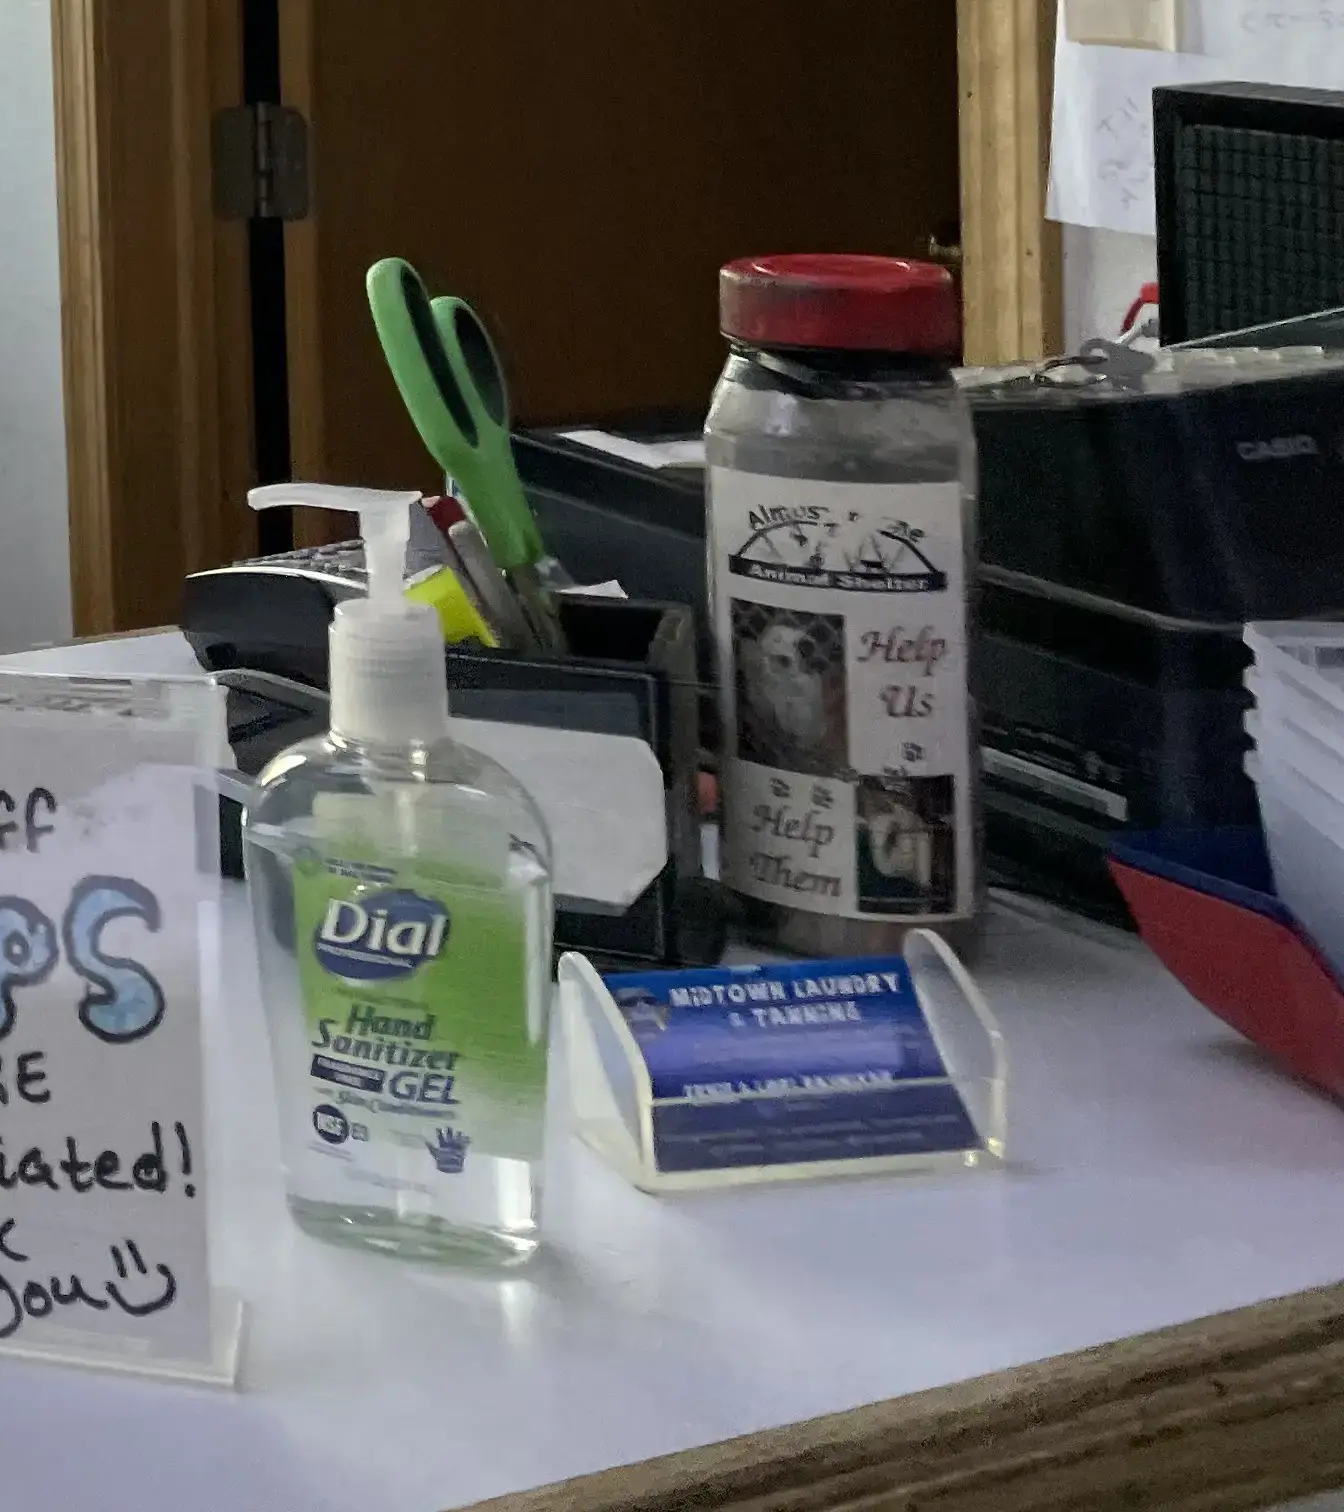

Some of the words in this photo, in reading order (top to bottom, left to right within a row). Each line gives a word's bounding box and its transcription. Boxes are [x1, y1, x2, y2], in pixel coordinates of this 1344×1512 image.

[856, 625, 947, 677] Help
[878, 685, 936, 718] Us
[753, 804, 835, 858] Help
[750, 852, 842, 897] Them
[320, 897, 450, 957] Dial
[791, 972, 900, 999] LAUNDRY
[311, 1017, 461, 1071] Sanitizer
[346, 1002, 437, 1041] Hand
[387, 1069, 462, 1106] GEL
